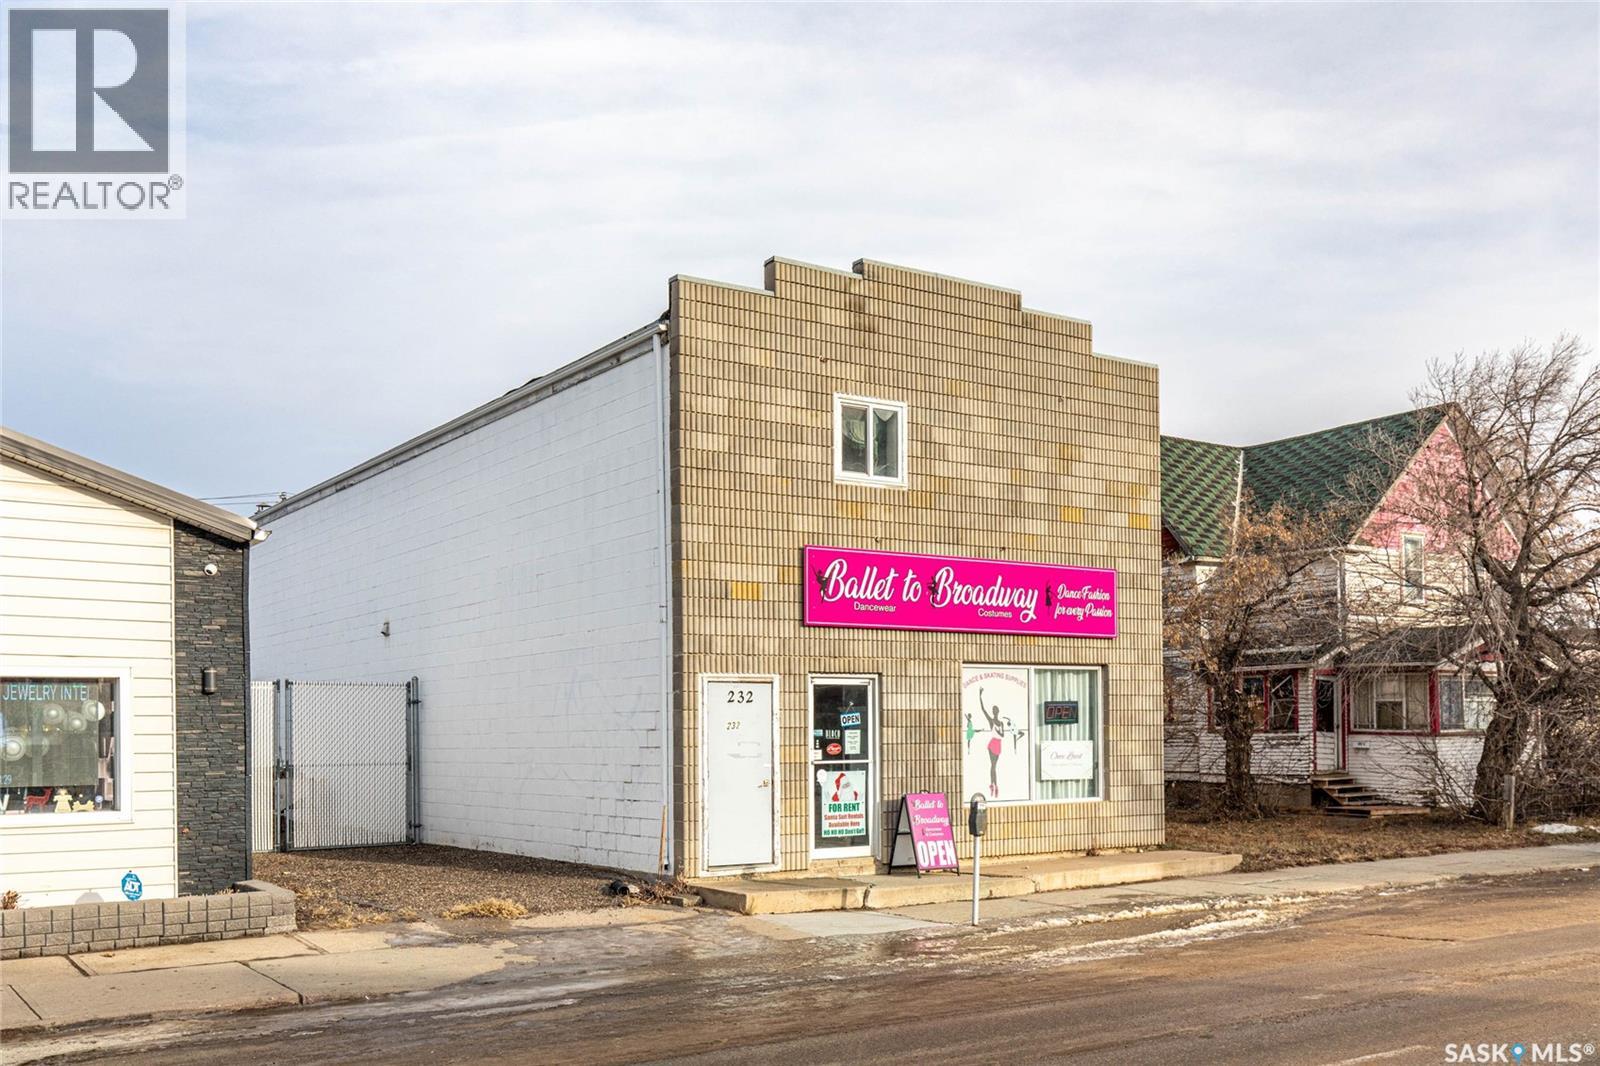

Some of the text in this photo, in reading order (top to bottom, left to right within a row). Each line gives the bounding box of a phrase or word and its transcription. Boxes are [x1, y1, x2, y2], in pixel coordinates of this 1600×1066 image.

[821, 558, 1039, 623] Ballet to Broadway
[1057, 583, 1111, 601] Dance Fashion
[853, 601, 896, 613] Dancewear
[978, 608, 1012, 618] Costumes
[1084, 602, 1113, 618] Passion
[2, 684, 57, 701] JEWELRY
[727, 690, 754, 704] 232
[842, 714, 860, 724] OPEN
[828, 802, 860, 813] FOR RENT
[917, 839, 957, 867] OPEN
